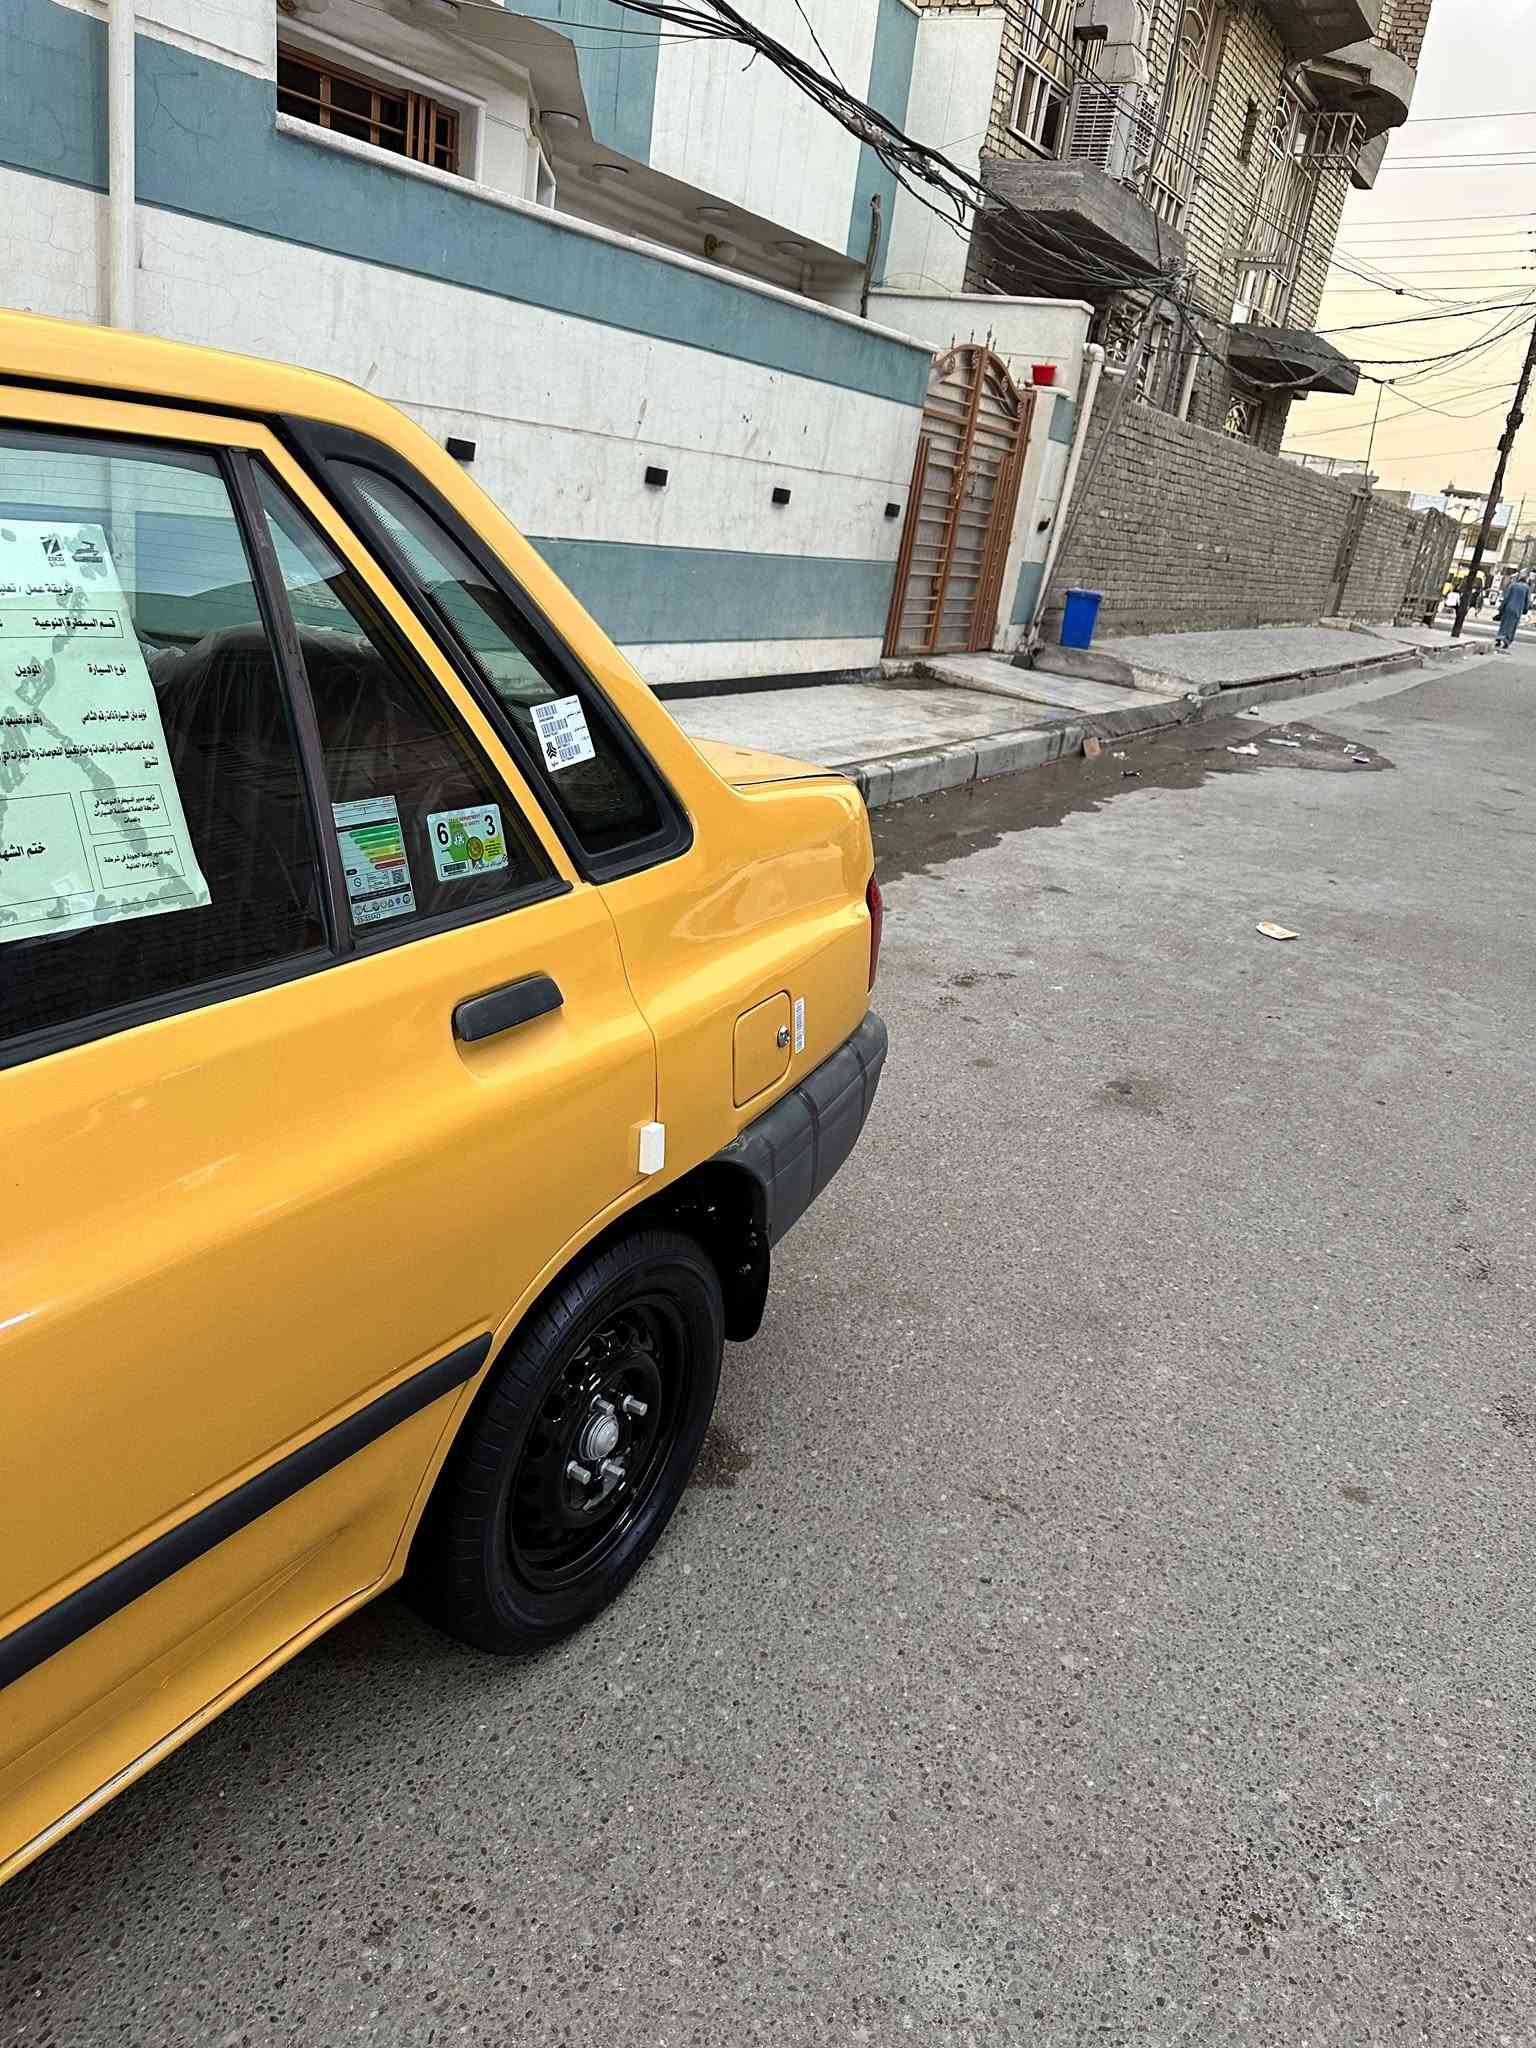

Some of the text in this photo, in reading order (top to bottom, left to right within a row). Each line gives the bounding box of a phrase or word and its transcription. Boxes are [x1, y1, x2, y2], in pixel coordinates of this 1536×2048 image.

[45, 582, 74, 596] طريقة
[32, 617, 116, 630] قسم السيطرة النوعية
[15, 664, 41, 677] الموديل
[87, 663, 127, 676] نوع السيارة
[484, 814, 496, 836] 3
[436, 822, 449, 845] 6
[0, 842, 46, 861] ختم الشه
